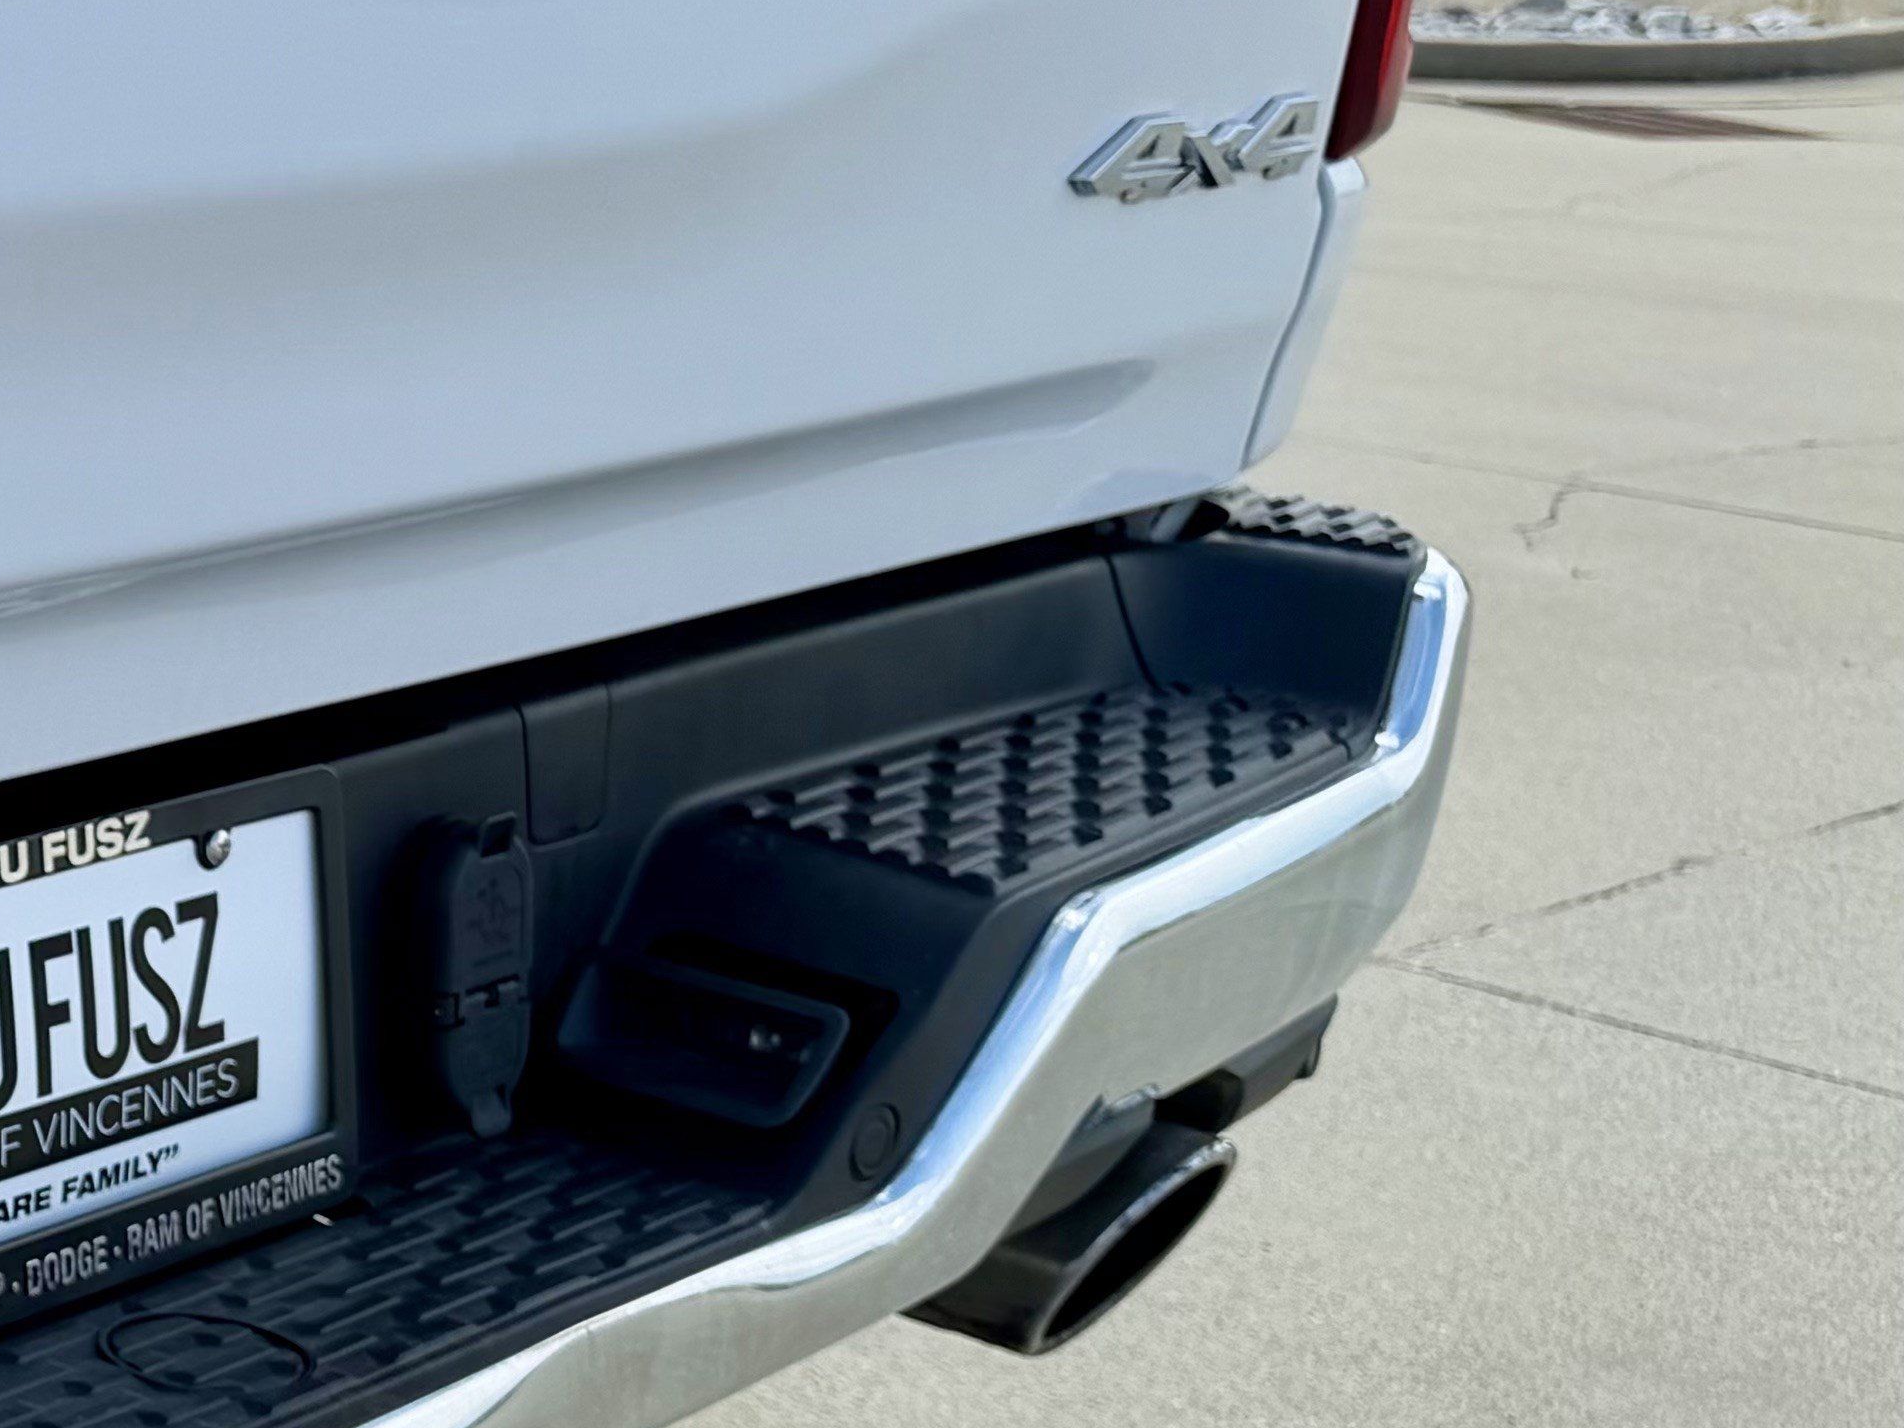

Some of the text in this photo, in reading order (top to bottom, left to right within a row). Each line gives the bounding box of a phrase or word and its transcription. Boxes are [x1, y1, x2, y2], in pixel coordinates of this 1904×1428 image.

[41, 809, 153, 874] FUSZ
[26, 891, 226, 1098] FUSZ
[32, 1058, 240, 1156] VINCENNES
[26, 1235, 111, 1298] DODGE
[127, 1209, 182, 1262] RAM
[186, 1197, 218, 1242] OF
[219, 1153, 344, 1229] VINCENNES
